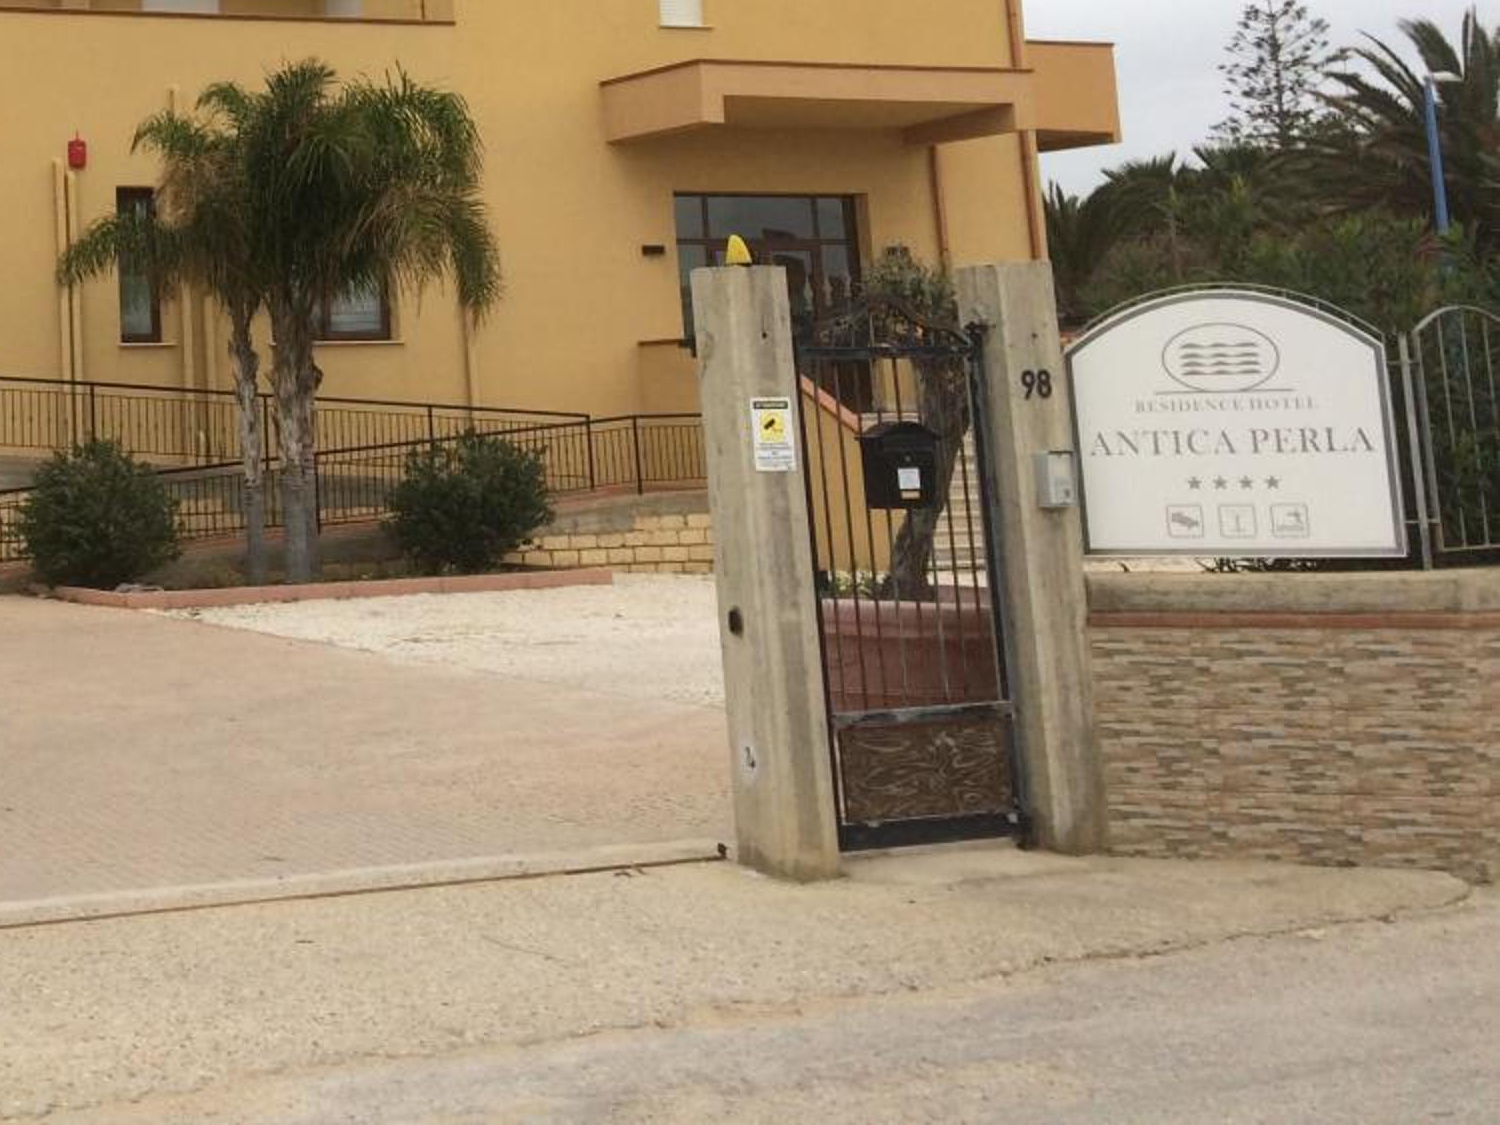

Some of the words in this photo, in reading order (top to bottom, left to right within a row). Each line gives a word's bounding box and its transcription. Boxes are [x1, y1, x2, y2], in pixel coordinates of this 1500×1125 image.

[1020, 370, 1053, 400] 98
[1134, 397, 1244, 413] RESIDENCE
[1250, 395, 1316, 411] HOTEL
[1090, 429, 1236, 457] ANTICA
[1251, 426, 1376, 455] PERLA
